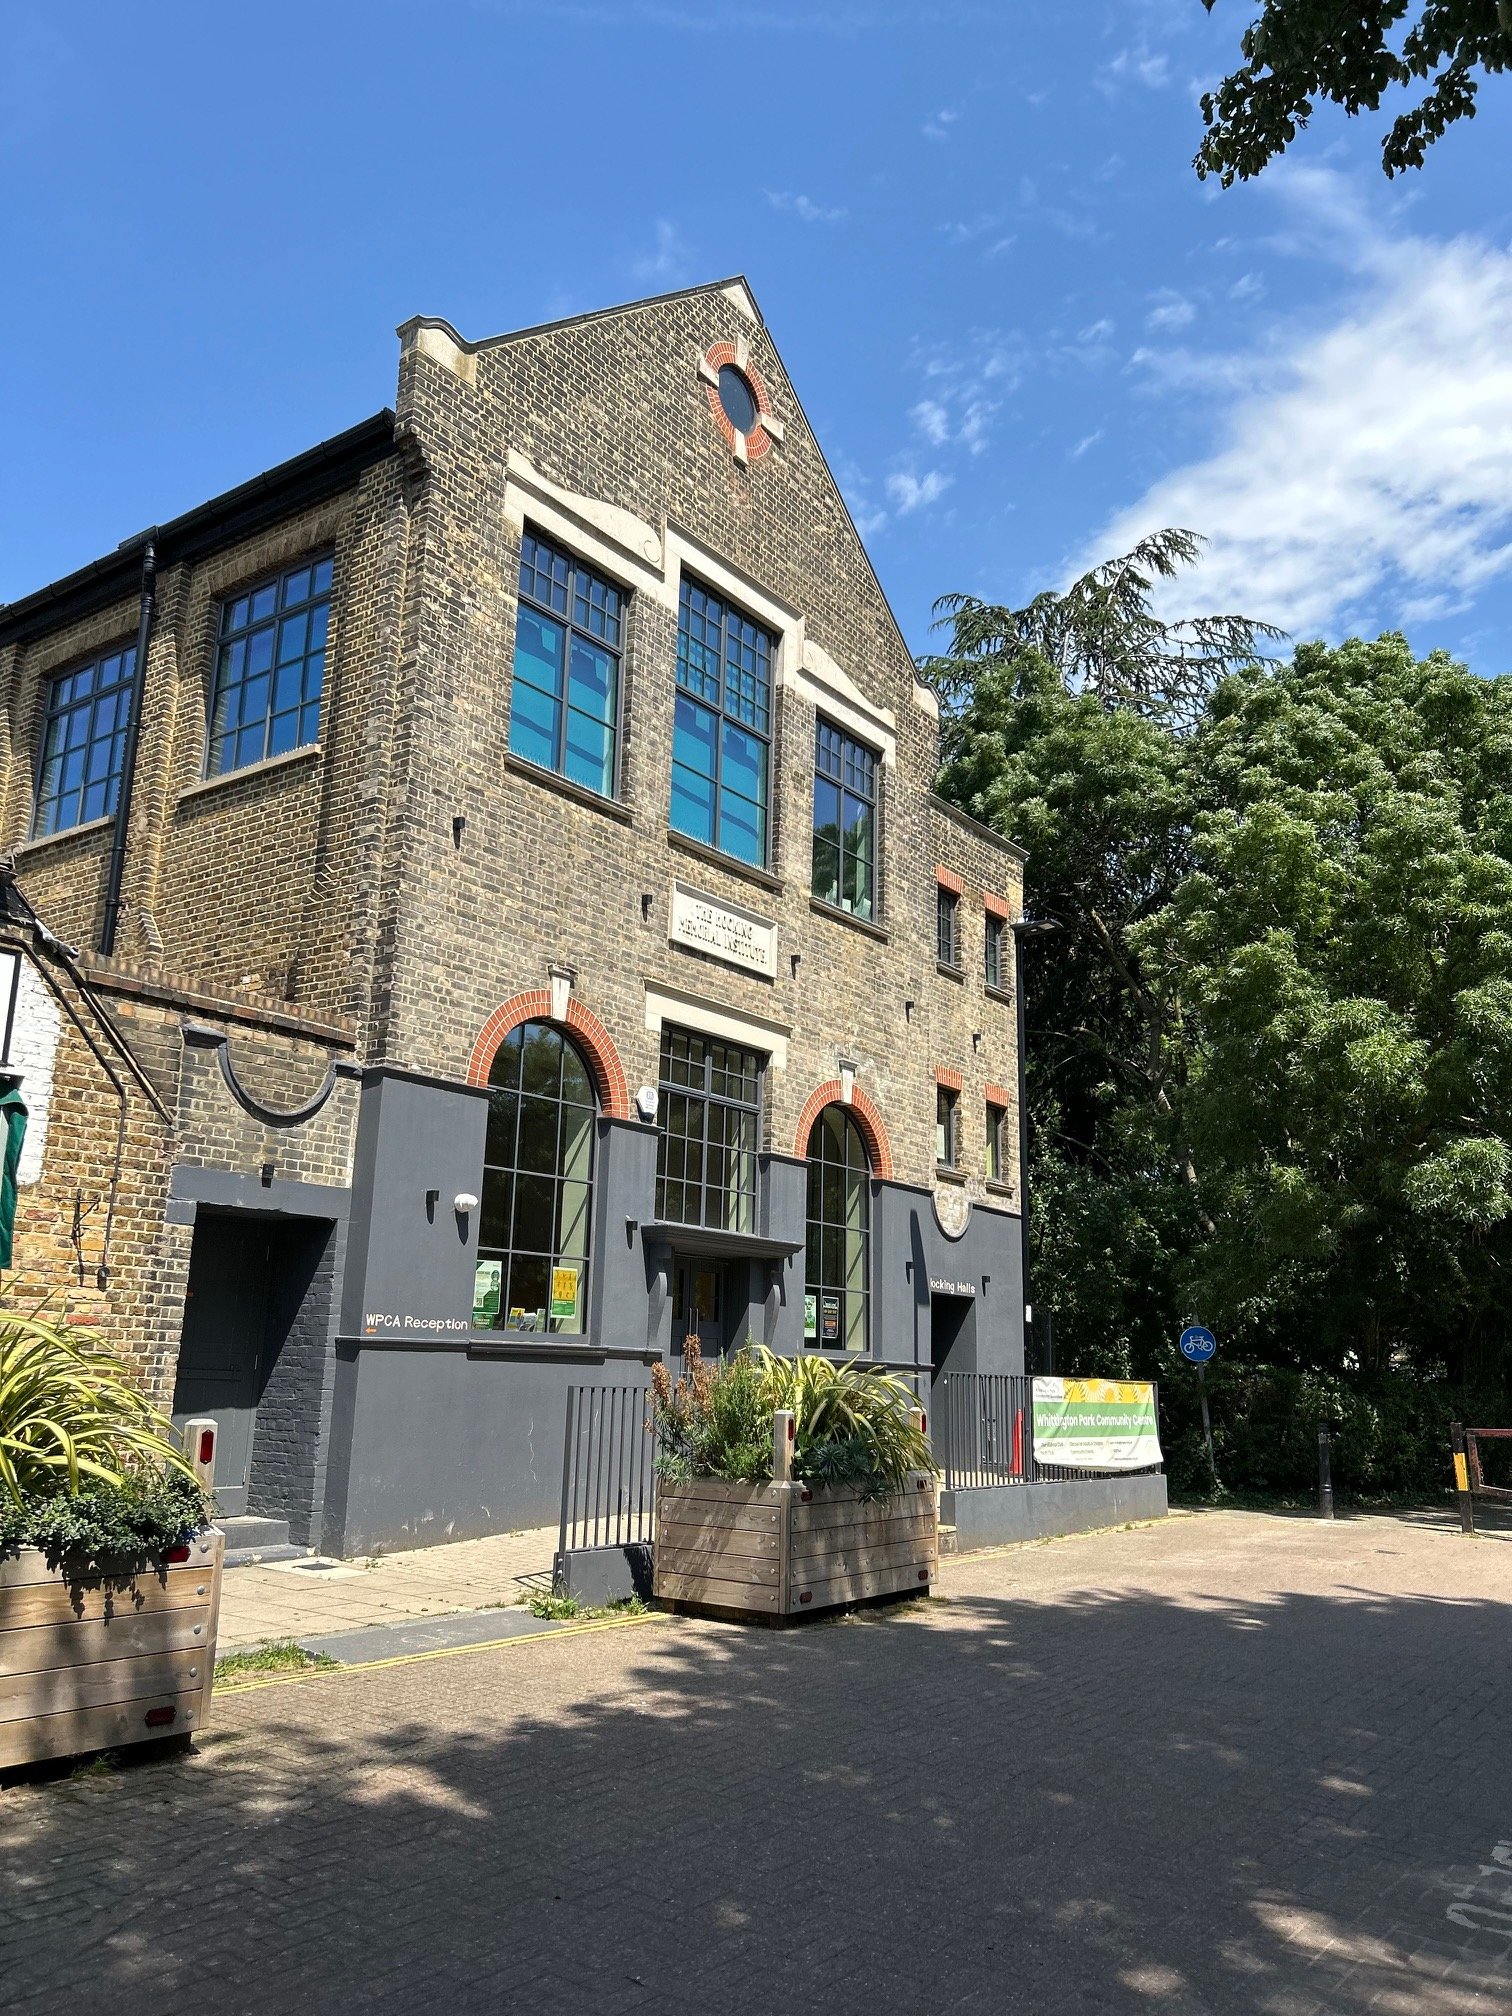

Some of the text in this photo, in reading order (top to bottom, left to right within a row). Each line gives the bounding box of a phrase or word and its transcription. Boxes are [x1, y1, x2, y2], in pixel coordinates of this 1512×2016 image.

[679, 916, 721, 946] MEMORIAL
[696, 904, 753, 940] THE HOCKING
[957, 1281, 976, 1294] Halls
[366, 1313, 401, 1327] WPCA
[404, 1315, 468, 1333] Reception
[1036, 1413, 1154, 1430] Whittington Park Community Centre
